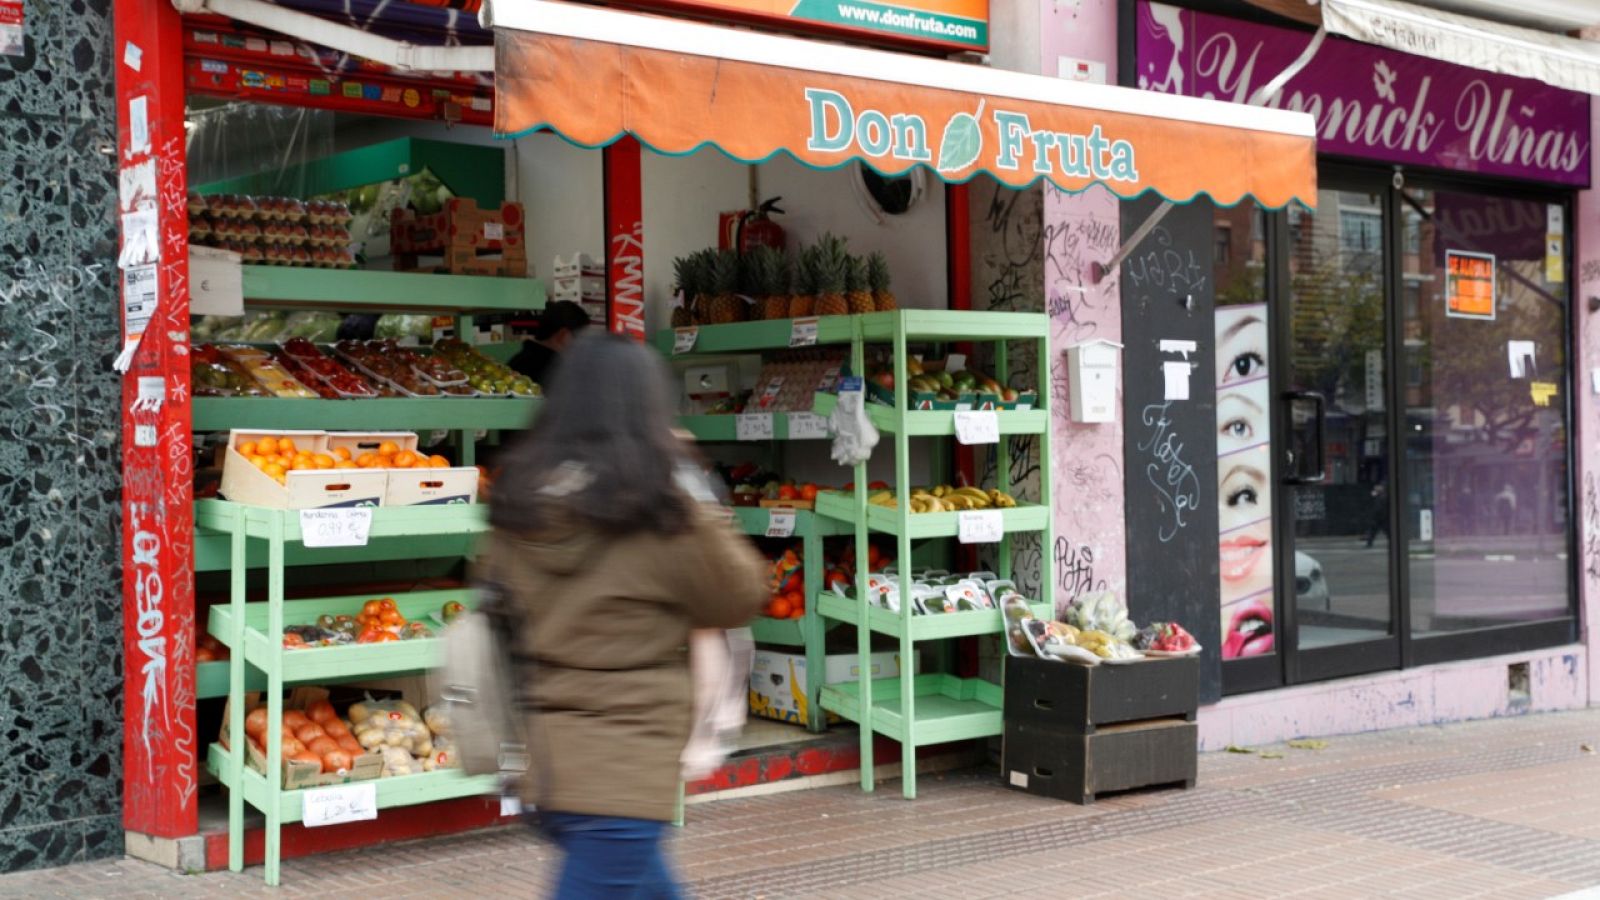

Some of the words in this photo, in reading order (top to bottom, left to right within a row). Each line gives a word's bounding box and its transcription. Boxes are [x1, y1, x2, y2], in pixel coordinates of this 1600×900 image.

[838, 3, 977, 40] www.donfruta.com
[804, 87, 932, 161] Don
[993, 109, 1139, 182] Fruta
[1454, 78, 1590, 173] Uñas
